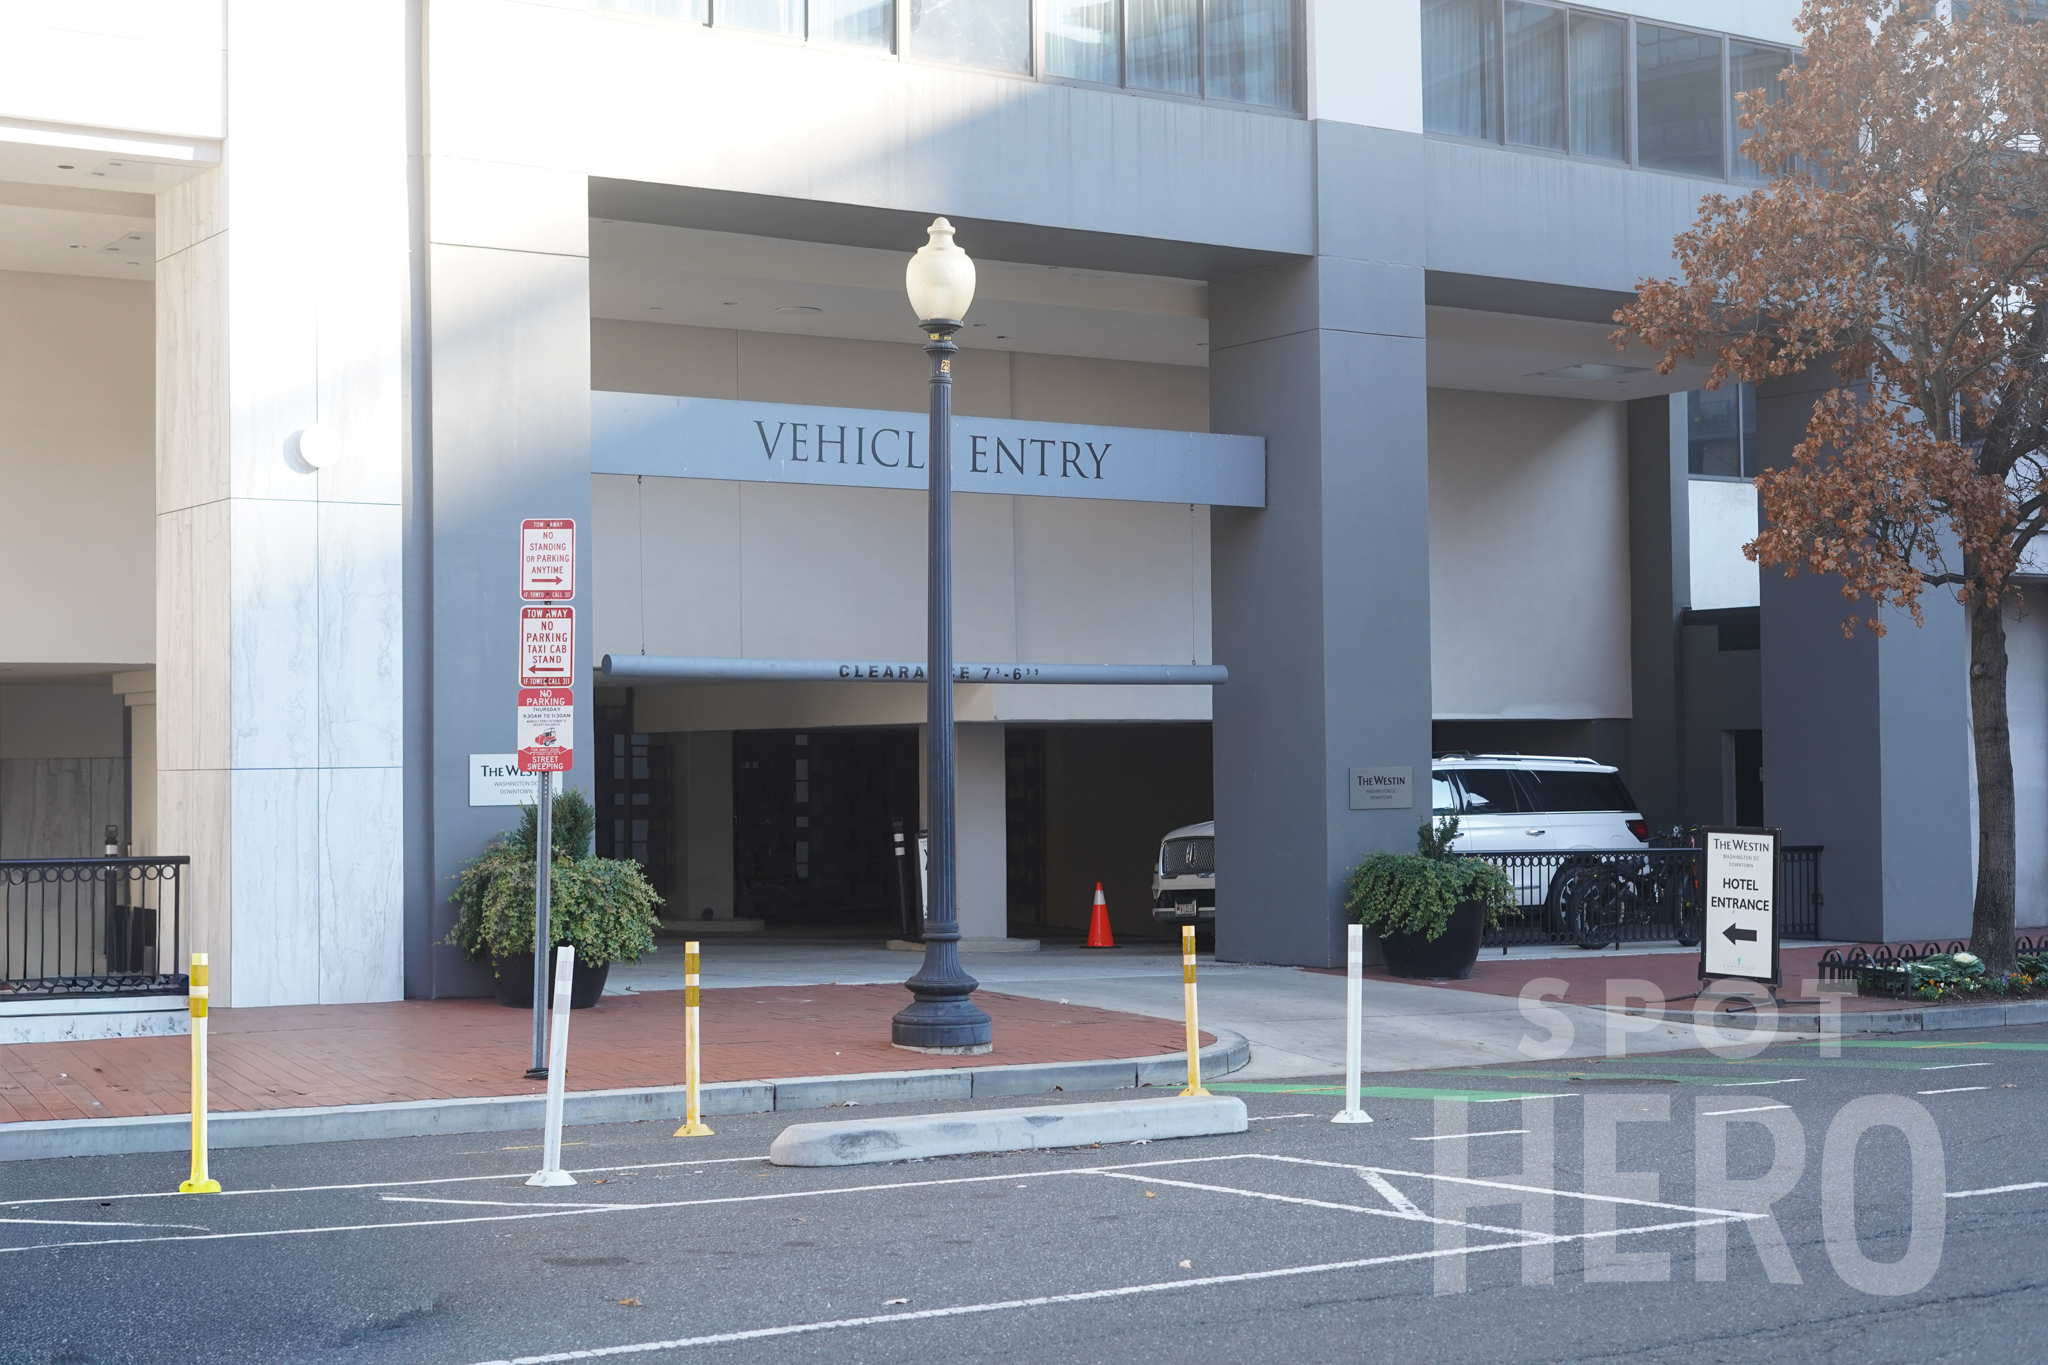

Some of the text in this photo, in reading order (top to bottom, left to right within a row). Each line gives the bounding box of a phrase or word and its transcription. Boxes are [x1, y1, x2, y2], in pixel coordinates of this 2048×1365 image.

[753, 420, 1112, 480] VEHICL ENTRY
[541, 621, 553, 630] NO
[527, 633, 568, 642] PARKING
[528, 645, 567, 653] TAXI CAB
[840, 665, 969, 679] CLEARAE
[481, 765, 504, 776] THE
[1357, 776, 1405, 786] THE WESTIN
[1714, 838, 1769, 852] THE WESTIN
[1723, 878, 1759, 891] HOTEL
[1711, 896, 1770, 911] ENTRANCE
